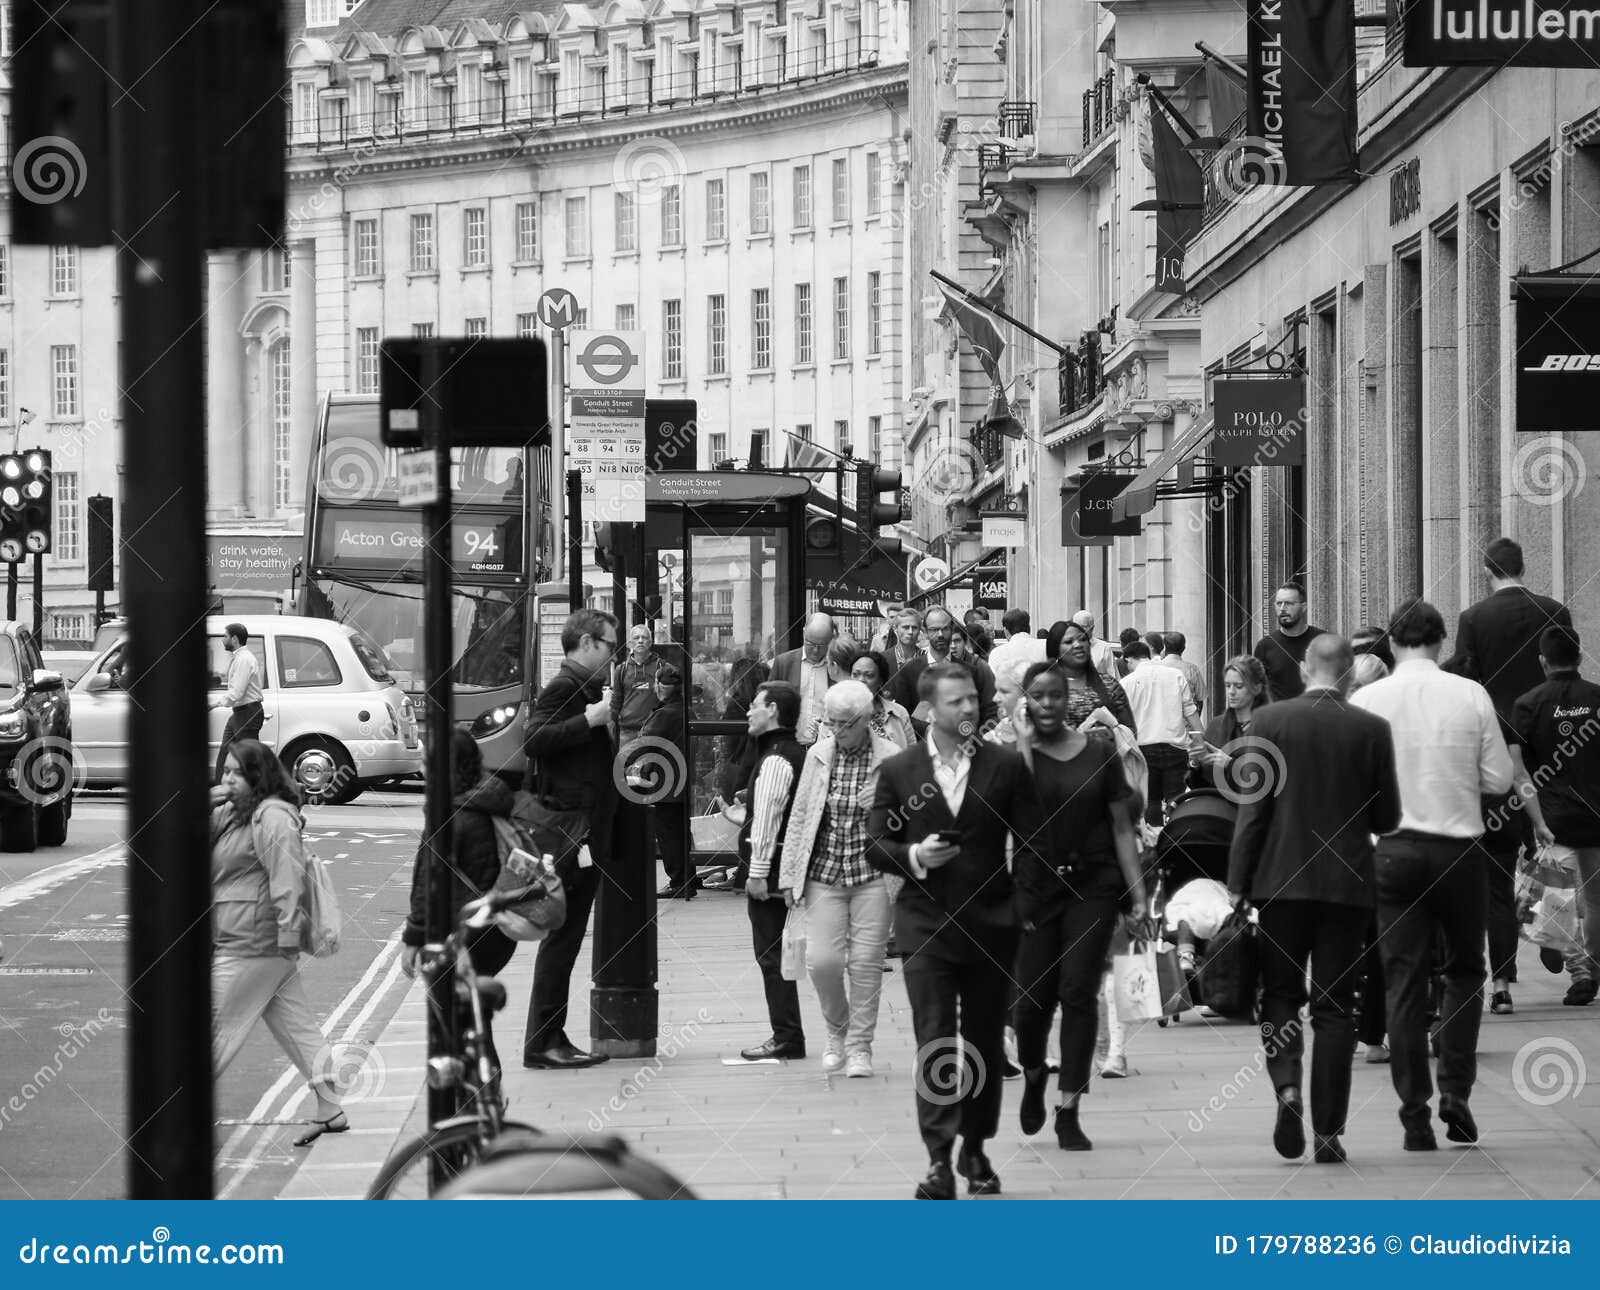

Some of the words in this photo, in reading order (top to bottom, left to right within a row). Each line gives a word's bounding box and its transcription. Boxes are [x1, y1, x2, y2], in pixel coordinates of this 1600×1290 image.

[1261, 0, 1282, 20] K
[1261, 33, 1284, 164] MICHAEL
[542, 293, 573, 323] M
[1234, 411, 1282, 426] POLO
[602, 445, 613, 453] 94
[579, 465, 592, 473] 53
[660, 478, 695, 486] Conduit
[696, 478, 721, 486] Street
[339, 529, 384, 546] Acton
[463, 530, 499, 556] 94
[220, 545, 247, 556] drink
[250, 545, 283, 557] water,
[219, 557, 242, 569] stay
[246, 557, 291, 570] healthy!
[805, 579, 849, 591] ZARA
[857, 586, 903, 600] HOME
[823, 598, 874, 610] BURBERRY
[1553, 705, 1591, 717] barista
